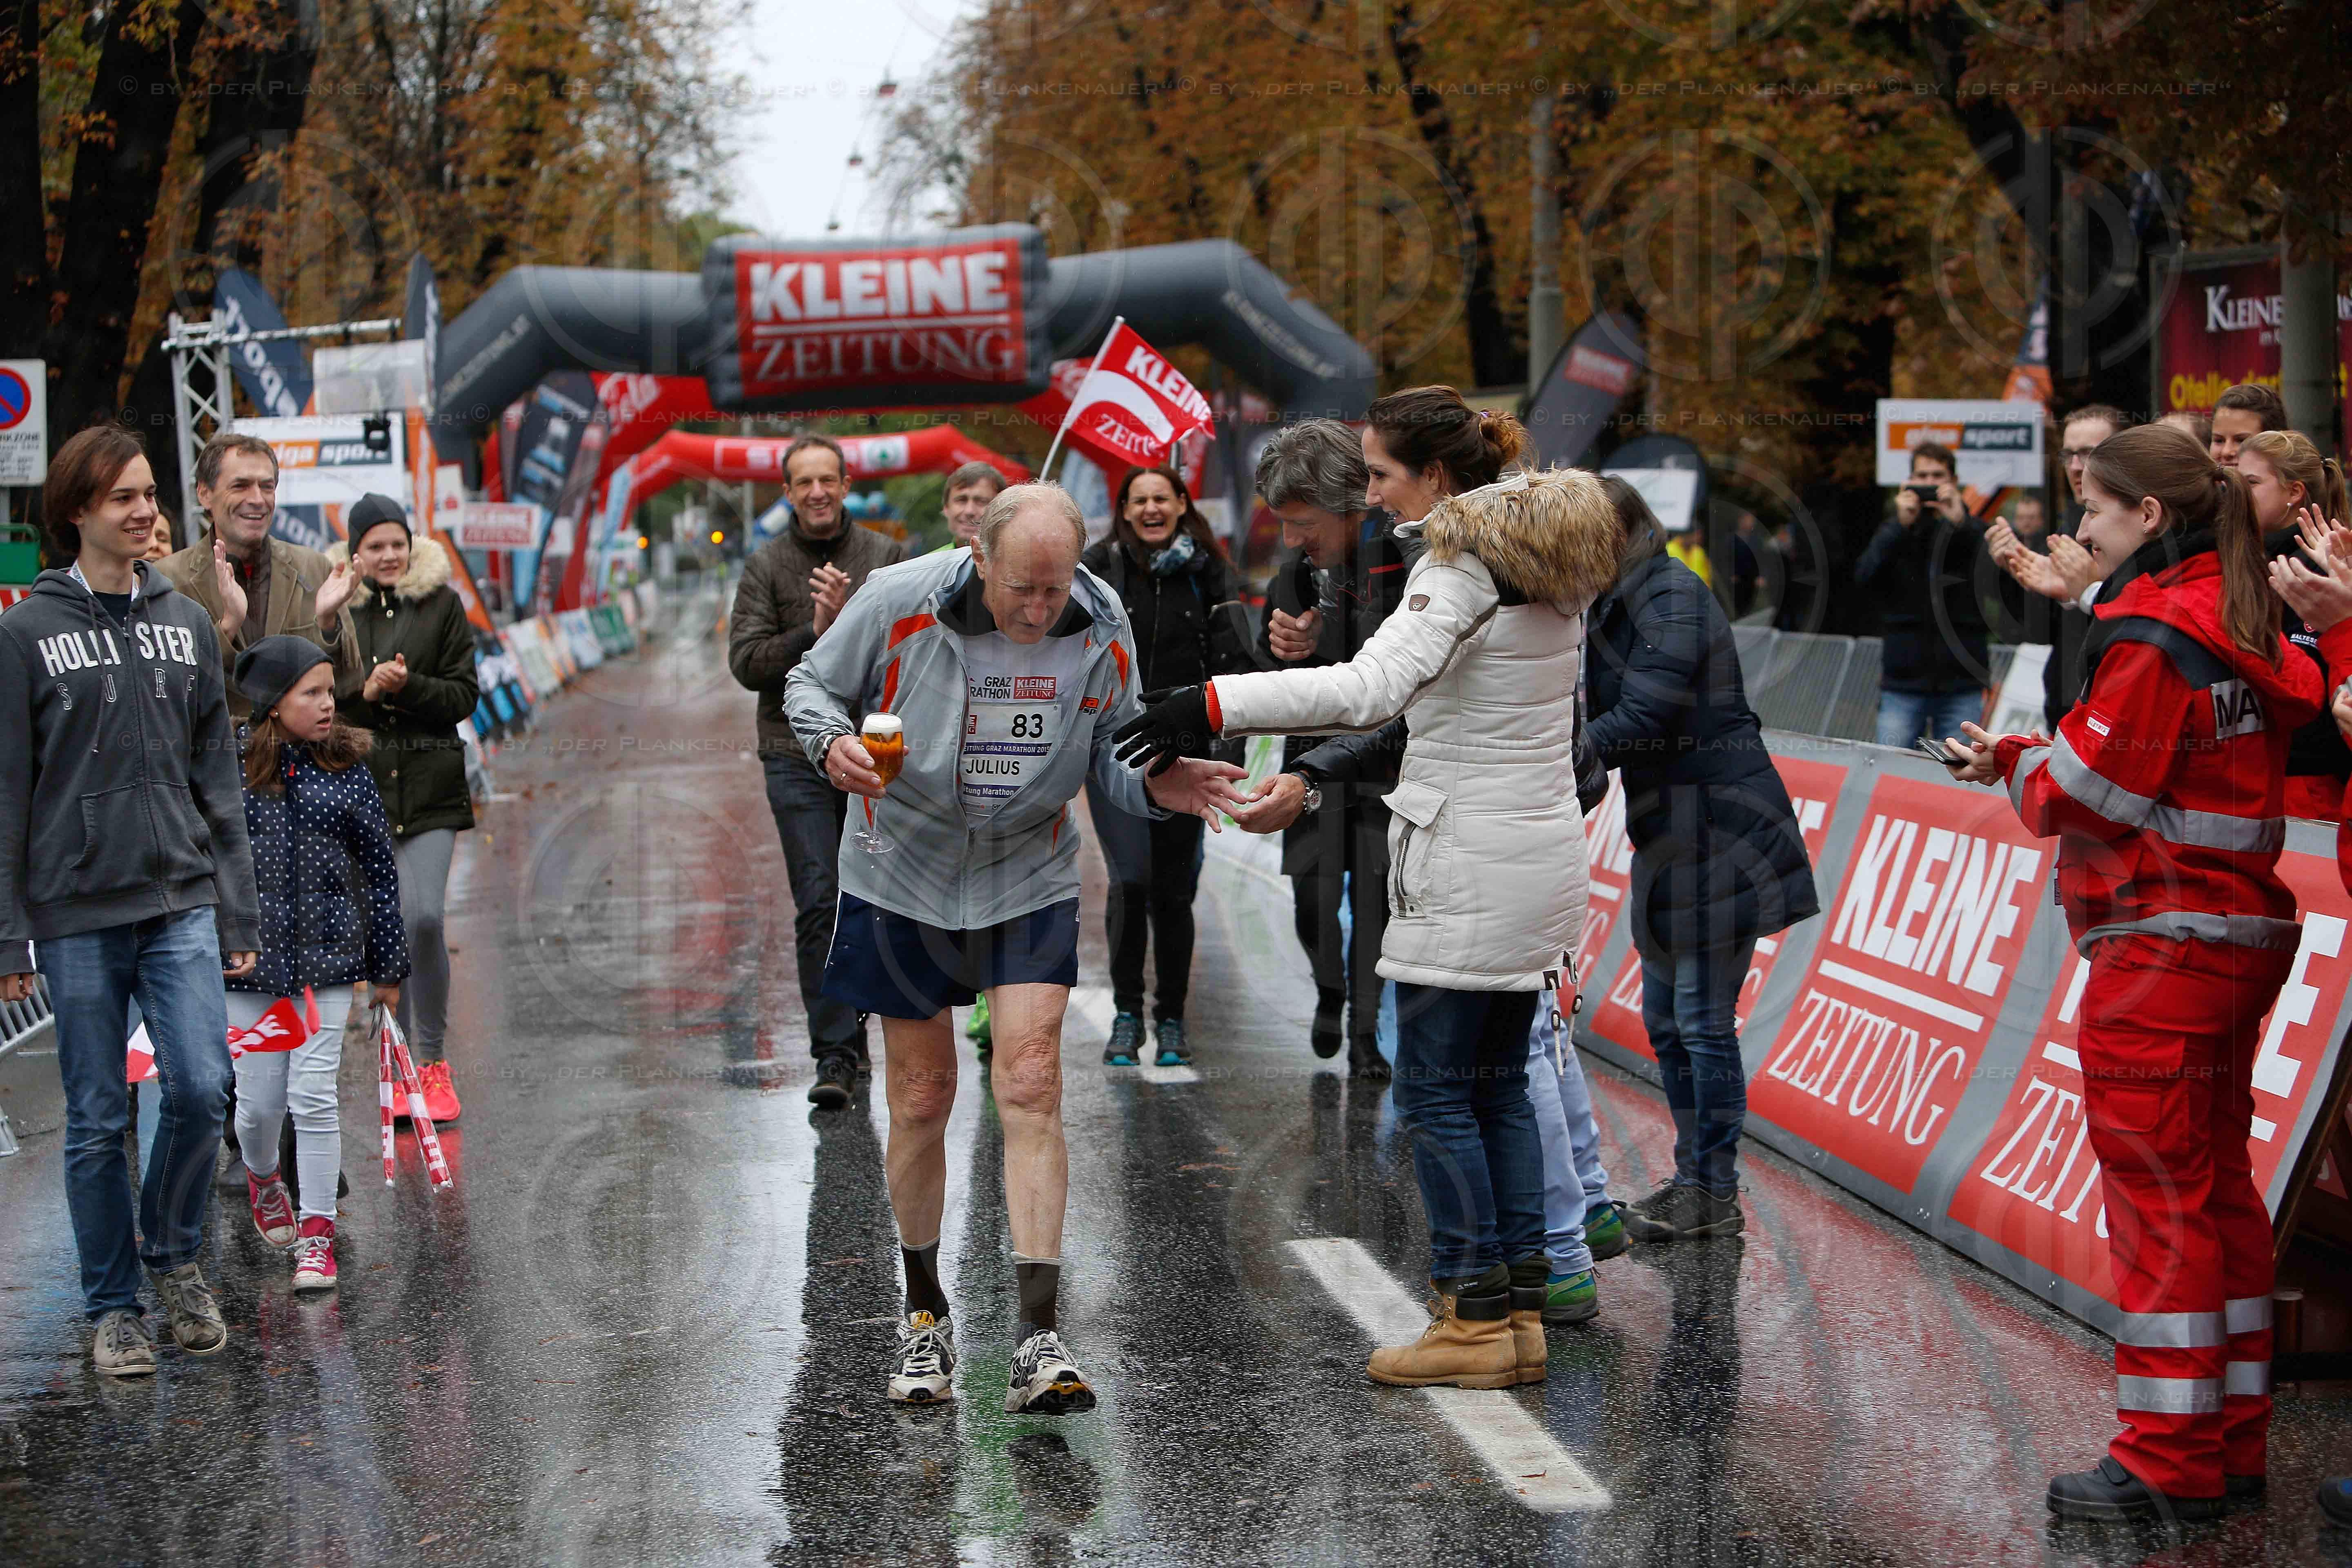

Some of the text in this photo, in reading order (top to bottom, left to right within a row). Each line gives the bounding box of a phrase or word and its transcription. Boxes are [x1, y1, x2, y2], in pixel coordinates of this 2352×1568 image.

[750, 252, 1009, 322] KLEINE
[753, 327, 1015, 382] ZEITUNG
[2290, 634, 2318, 644] MALTESE
[984, 676, 1013, 687] GRAZ
[1016, 679, 1055, 688] KLEINE
[970, 687, 1011, 699] RATHON
[1016, 690, 1054, 698] ZEITUNG
[1011, 713, 1043, 738] 83
[965, 759, 1020, 775] JULIUS
[964, 786, 980, 796] itung
[1831, 813, 2041, 997] KLEINE
[1767, 987, 1967, 1145] ZEITUNG
